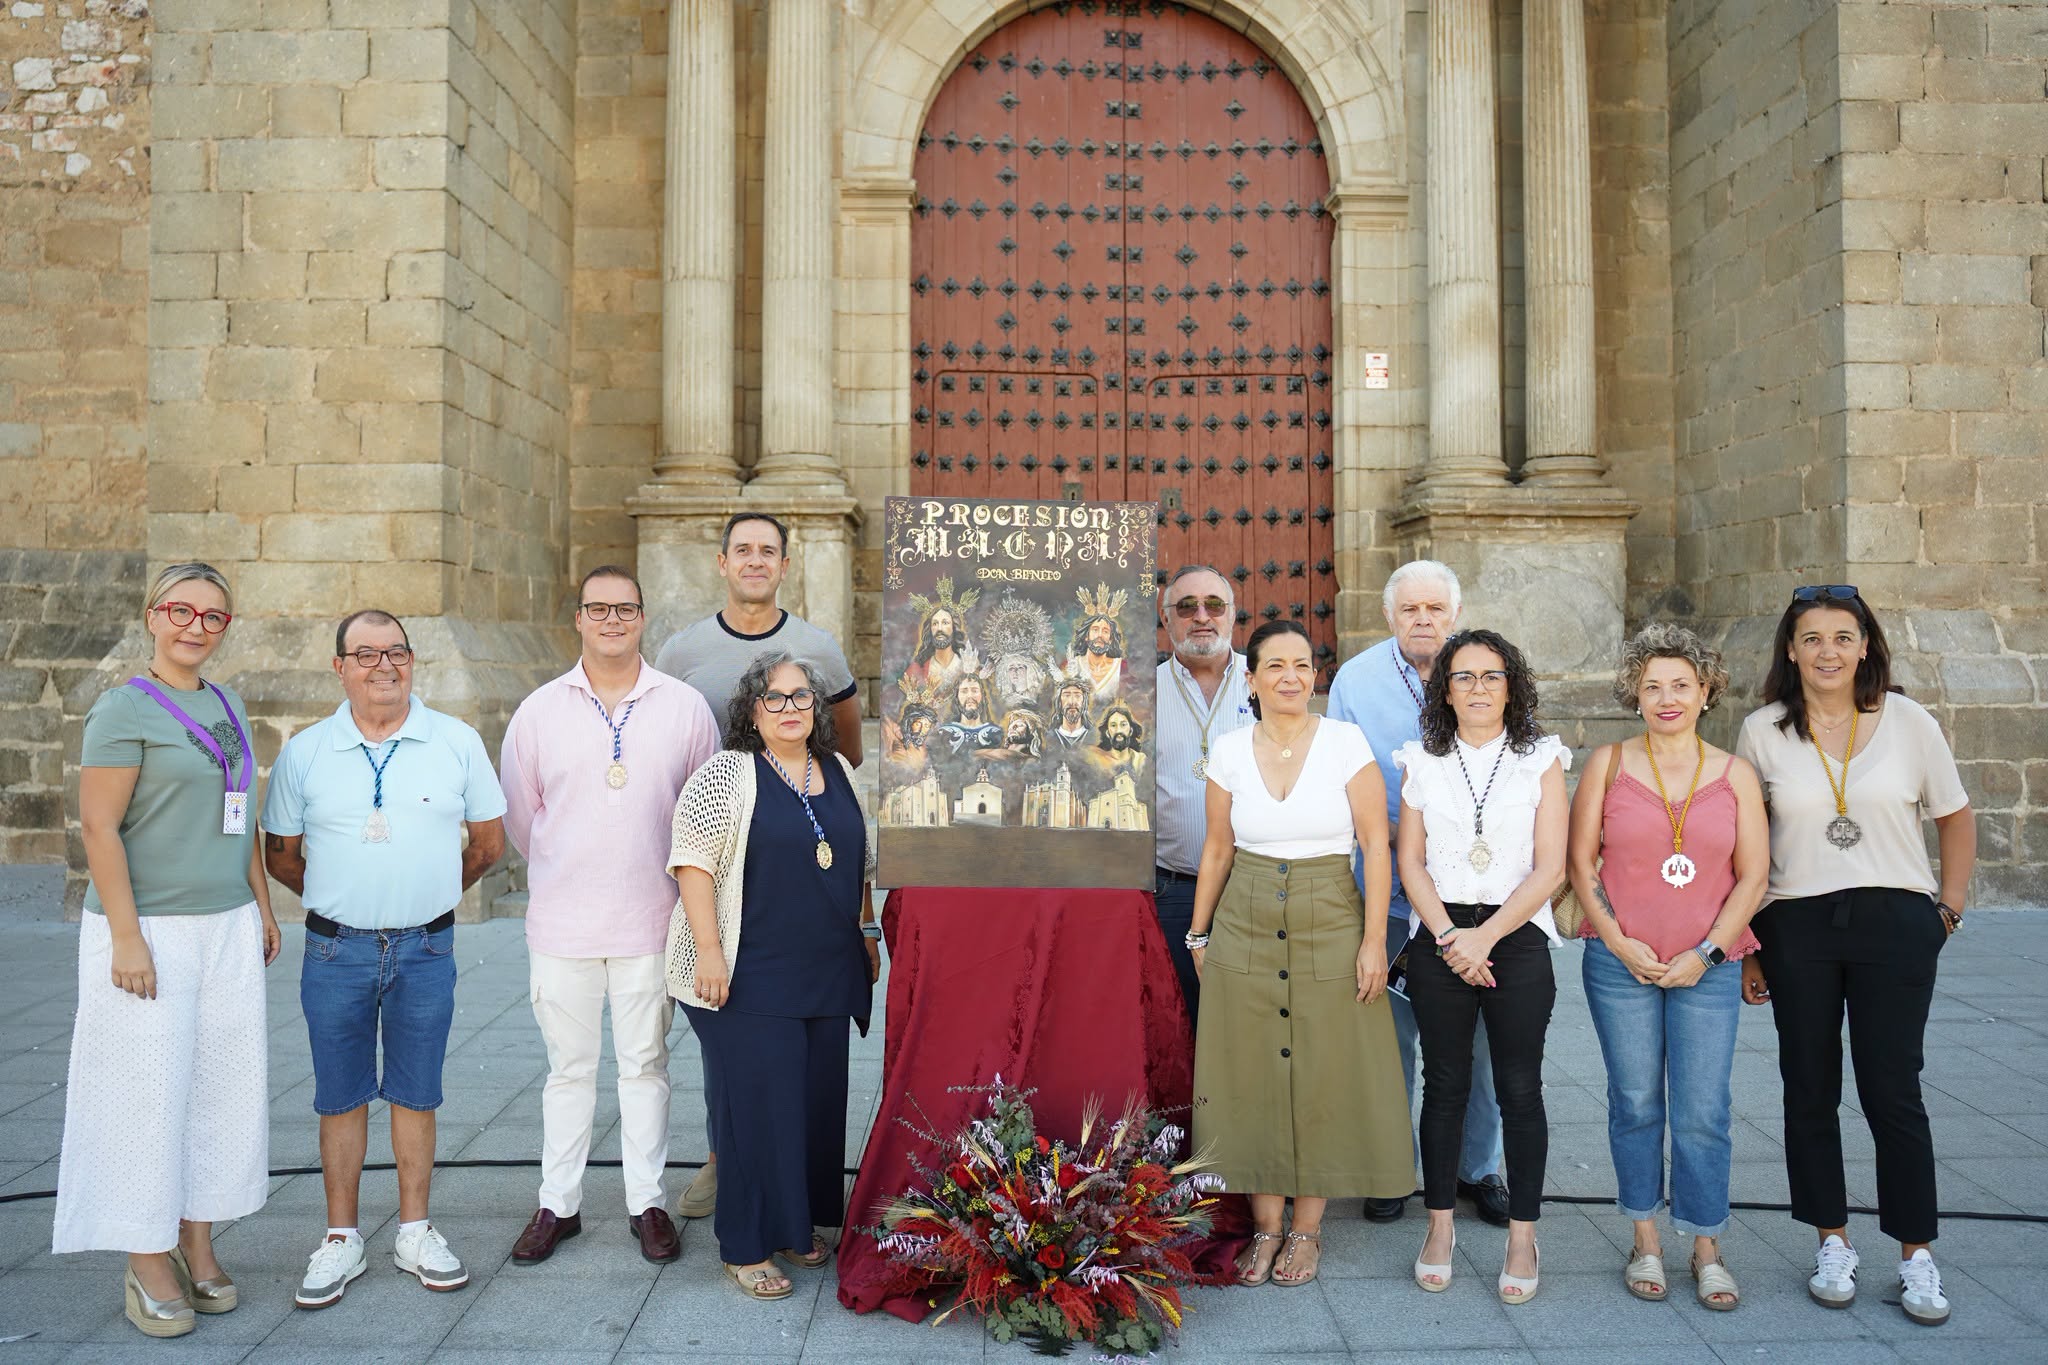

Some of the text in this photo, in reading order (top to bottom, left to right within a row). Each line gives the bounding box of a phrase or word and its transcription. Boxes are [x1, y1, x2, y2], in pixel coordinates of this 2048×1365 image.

[1118, 509, 1129, 569] 2026
[976, 567, 1062, 581] DON BENITO
